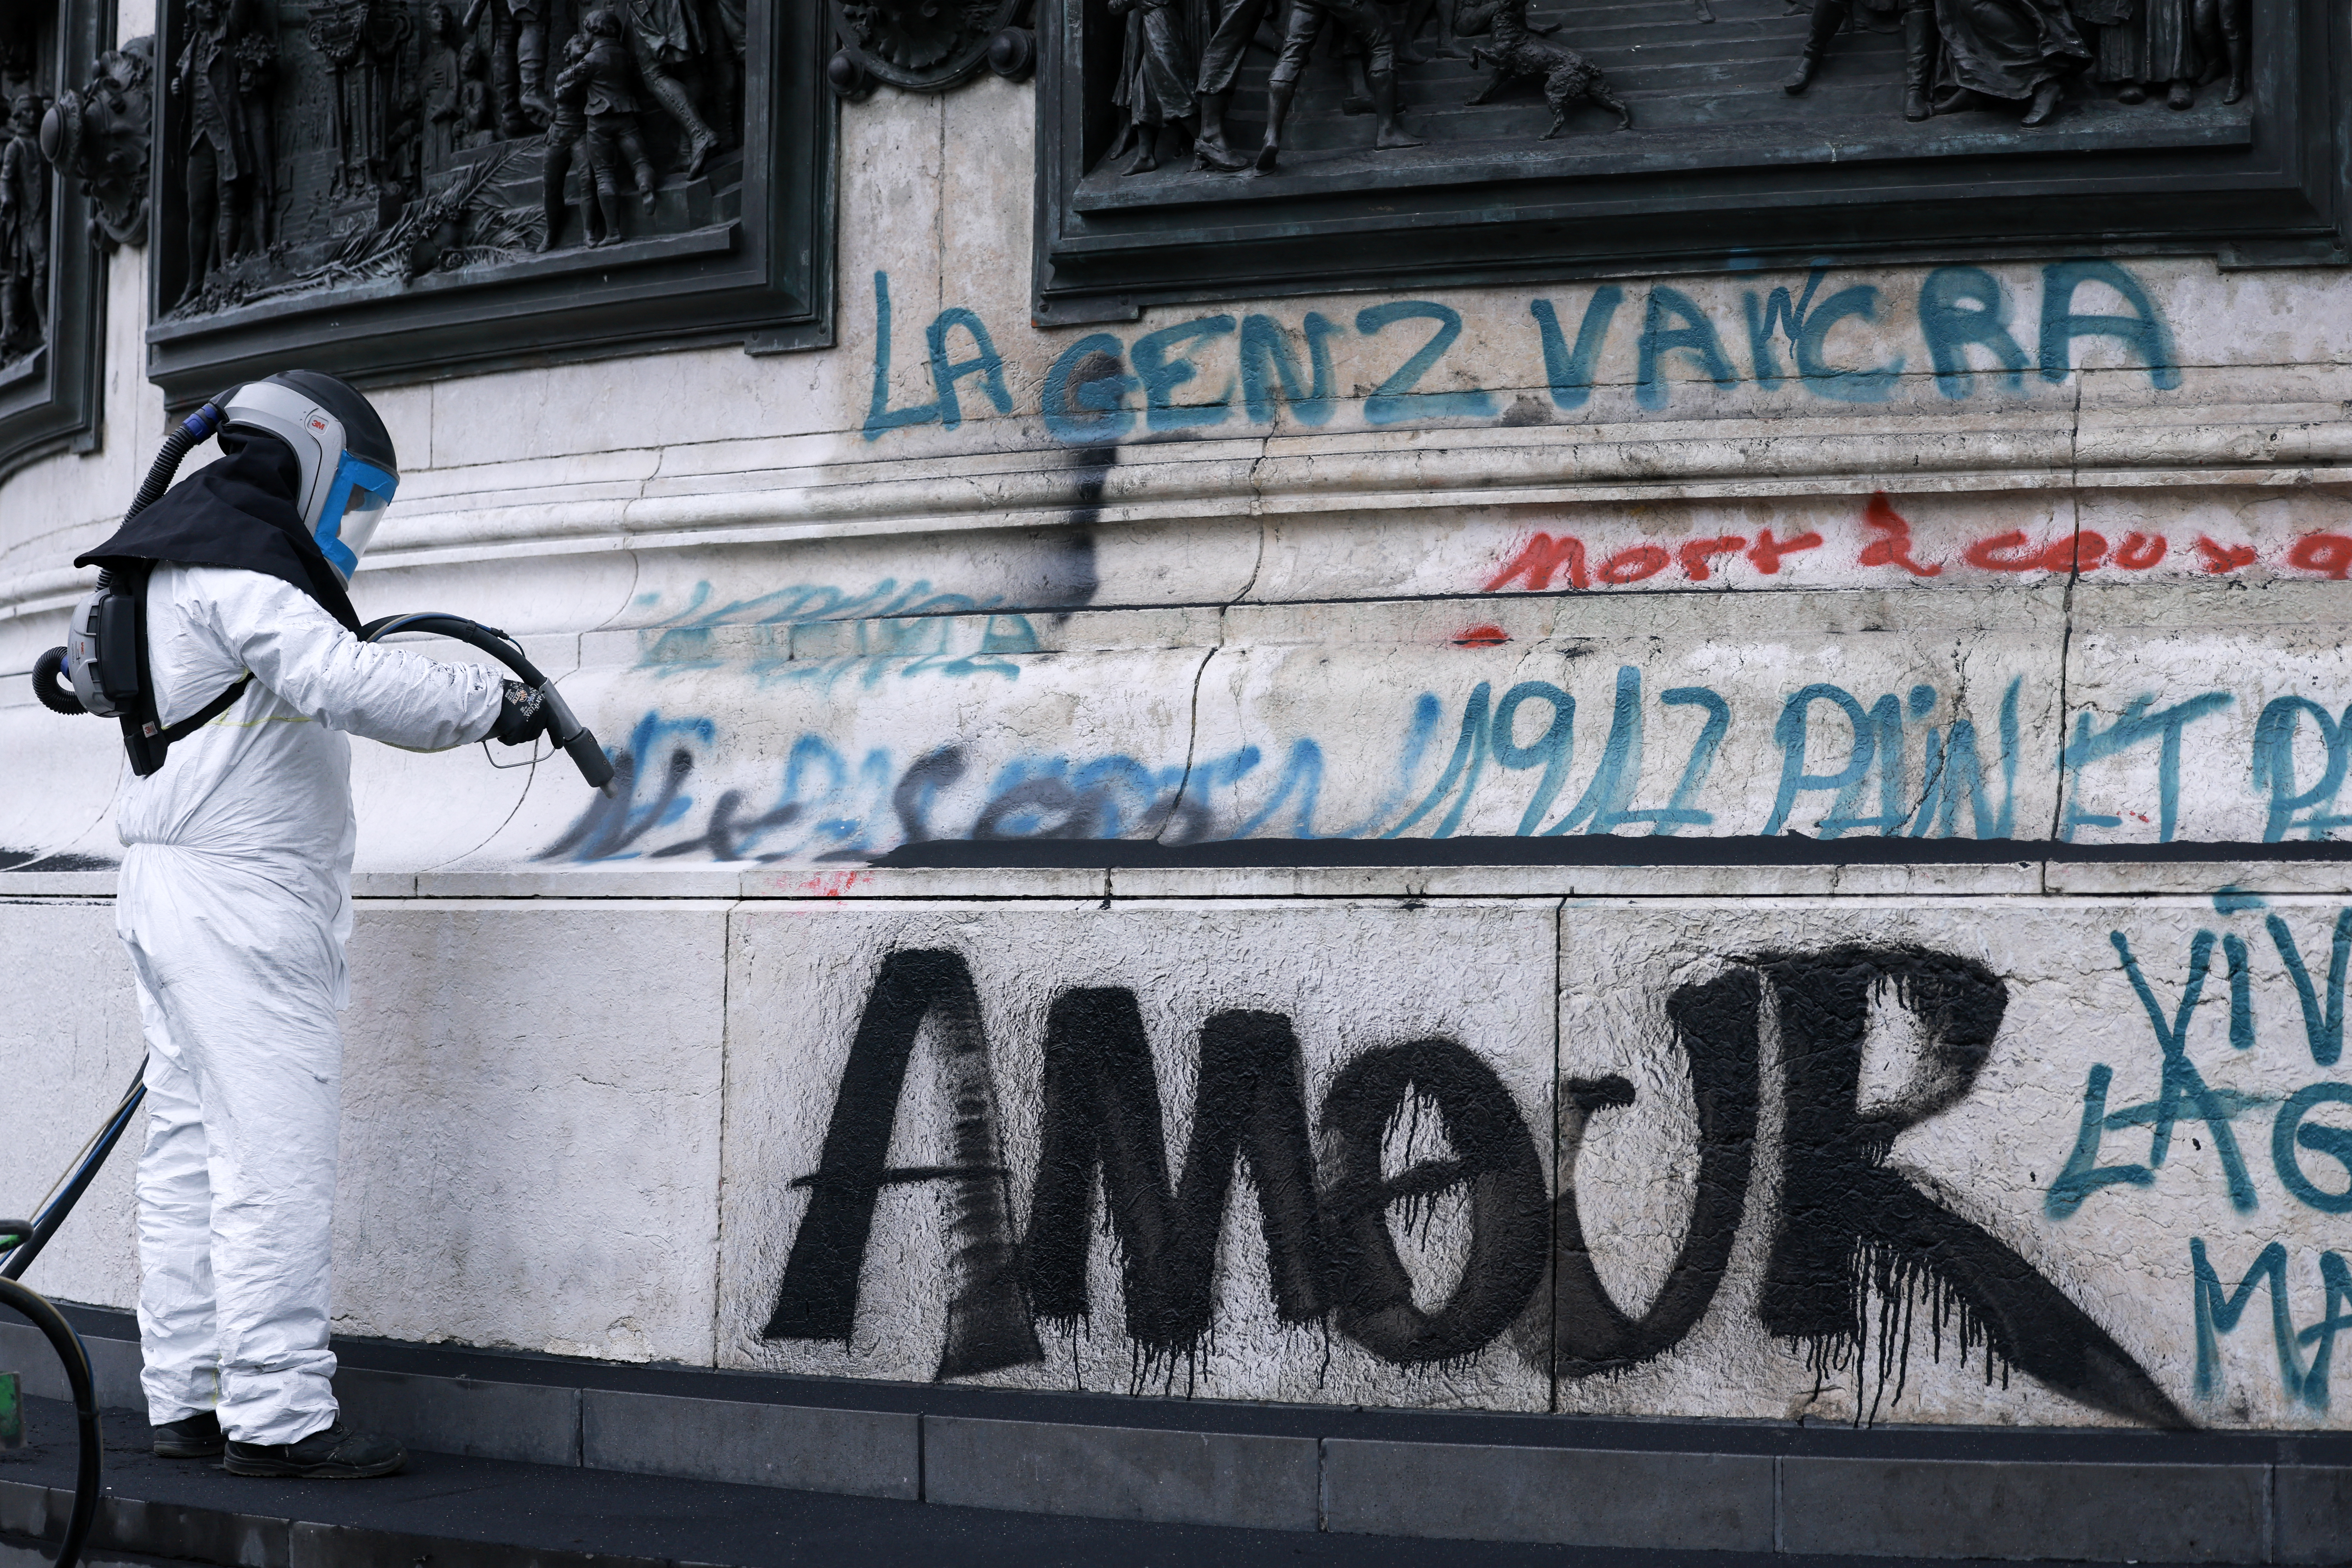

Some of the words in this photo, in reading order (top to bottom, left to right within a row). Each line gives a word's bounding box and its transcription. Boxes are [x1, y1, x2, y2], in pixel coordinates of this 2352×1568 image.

[312, 420, 325, 430] 3M
[862, 271, 1013, 441] LA
[764, 940, 2197, 1427] AMOUR
